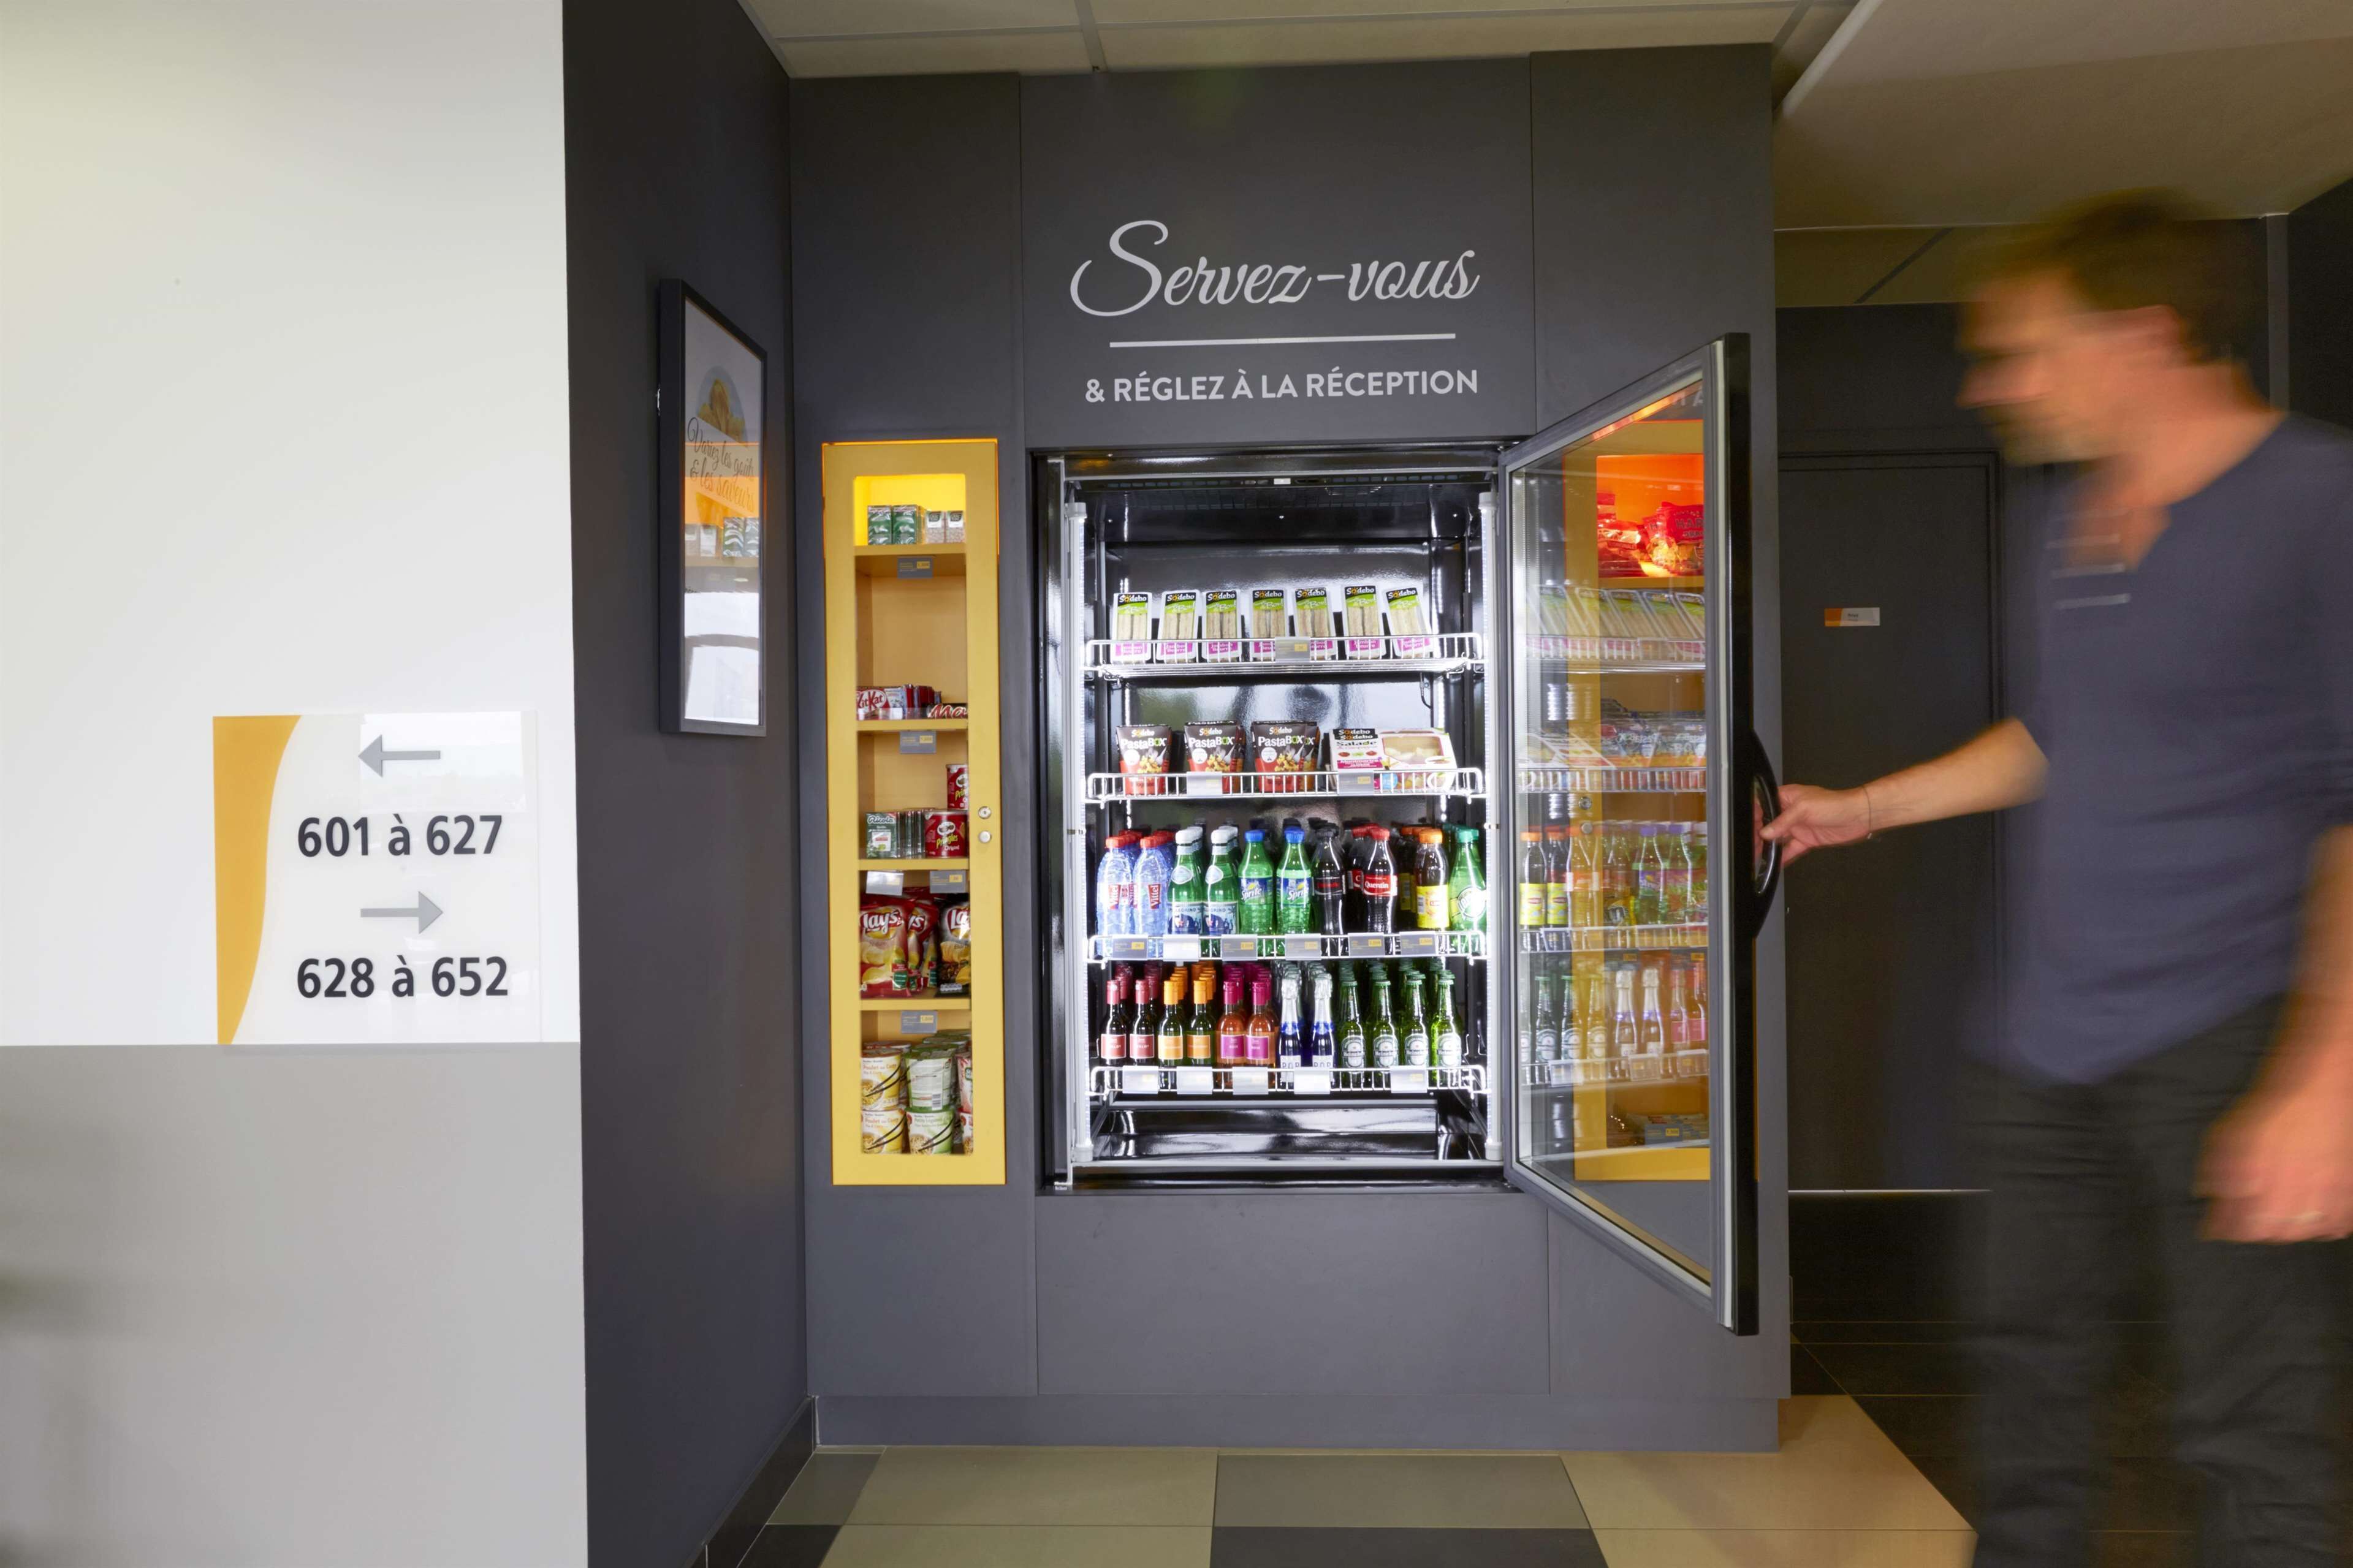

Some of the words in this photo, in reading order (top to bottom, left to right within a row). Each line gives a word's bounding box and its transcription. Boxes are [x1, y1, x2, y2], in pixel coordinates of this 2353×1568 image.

[1070, 220, 1480, 316] Servez-vous
[1085, 380, 1104, 402] &
[1114, 371, 1224, 401] RÉGLEZ
[1232, 369, 1253, 399] À
[1262, 374, 1298, 398] LA
[1307, 366, 1478, 397] RÉCEPTION
[687, 417, 720, 471] Variez
[721, 441, 731, 469] les
[690, 460, 700, 481] &
[701, 457, 714, 490] les
[717, 474, 754, 511] saveurs
[298, 816, 369, 857] 601
[389, 814, 411, 855] à
[426, 815, 503, 855] 627
[1150, 884, 1159, 907] Vittel
[297, 957, 374, 998] 628
[392, 955, 414, 997] à
[431, 956, 508, 997] 652
